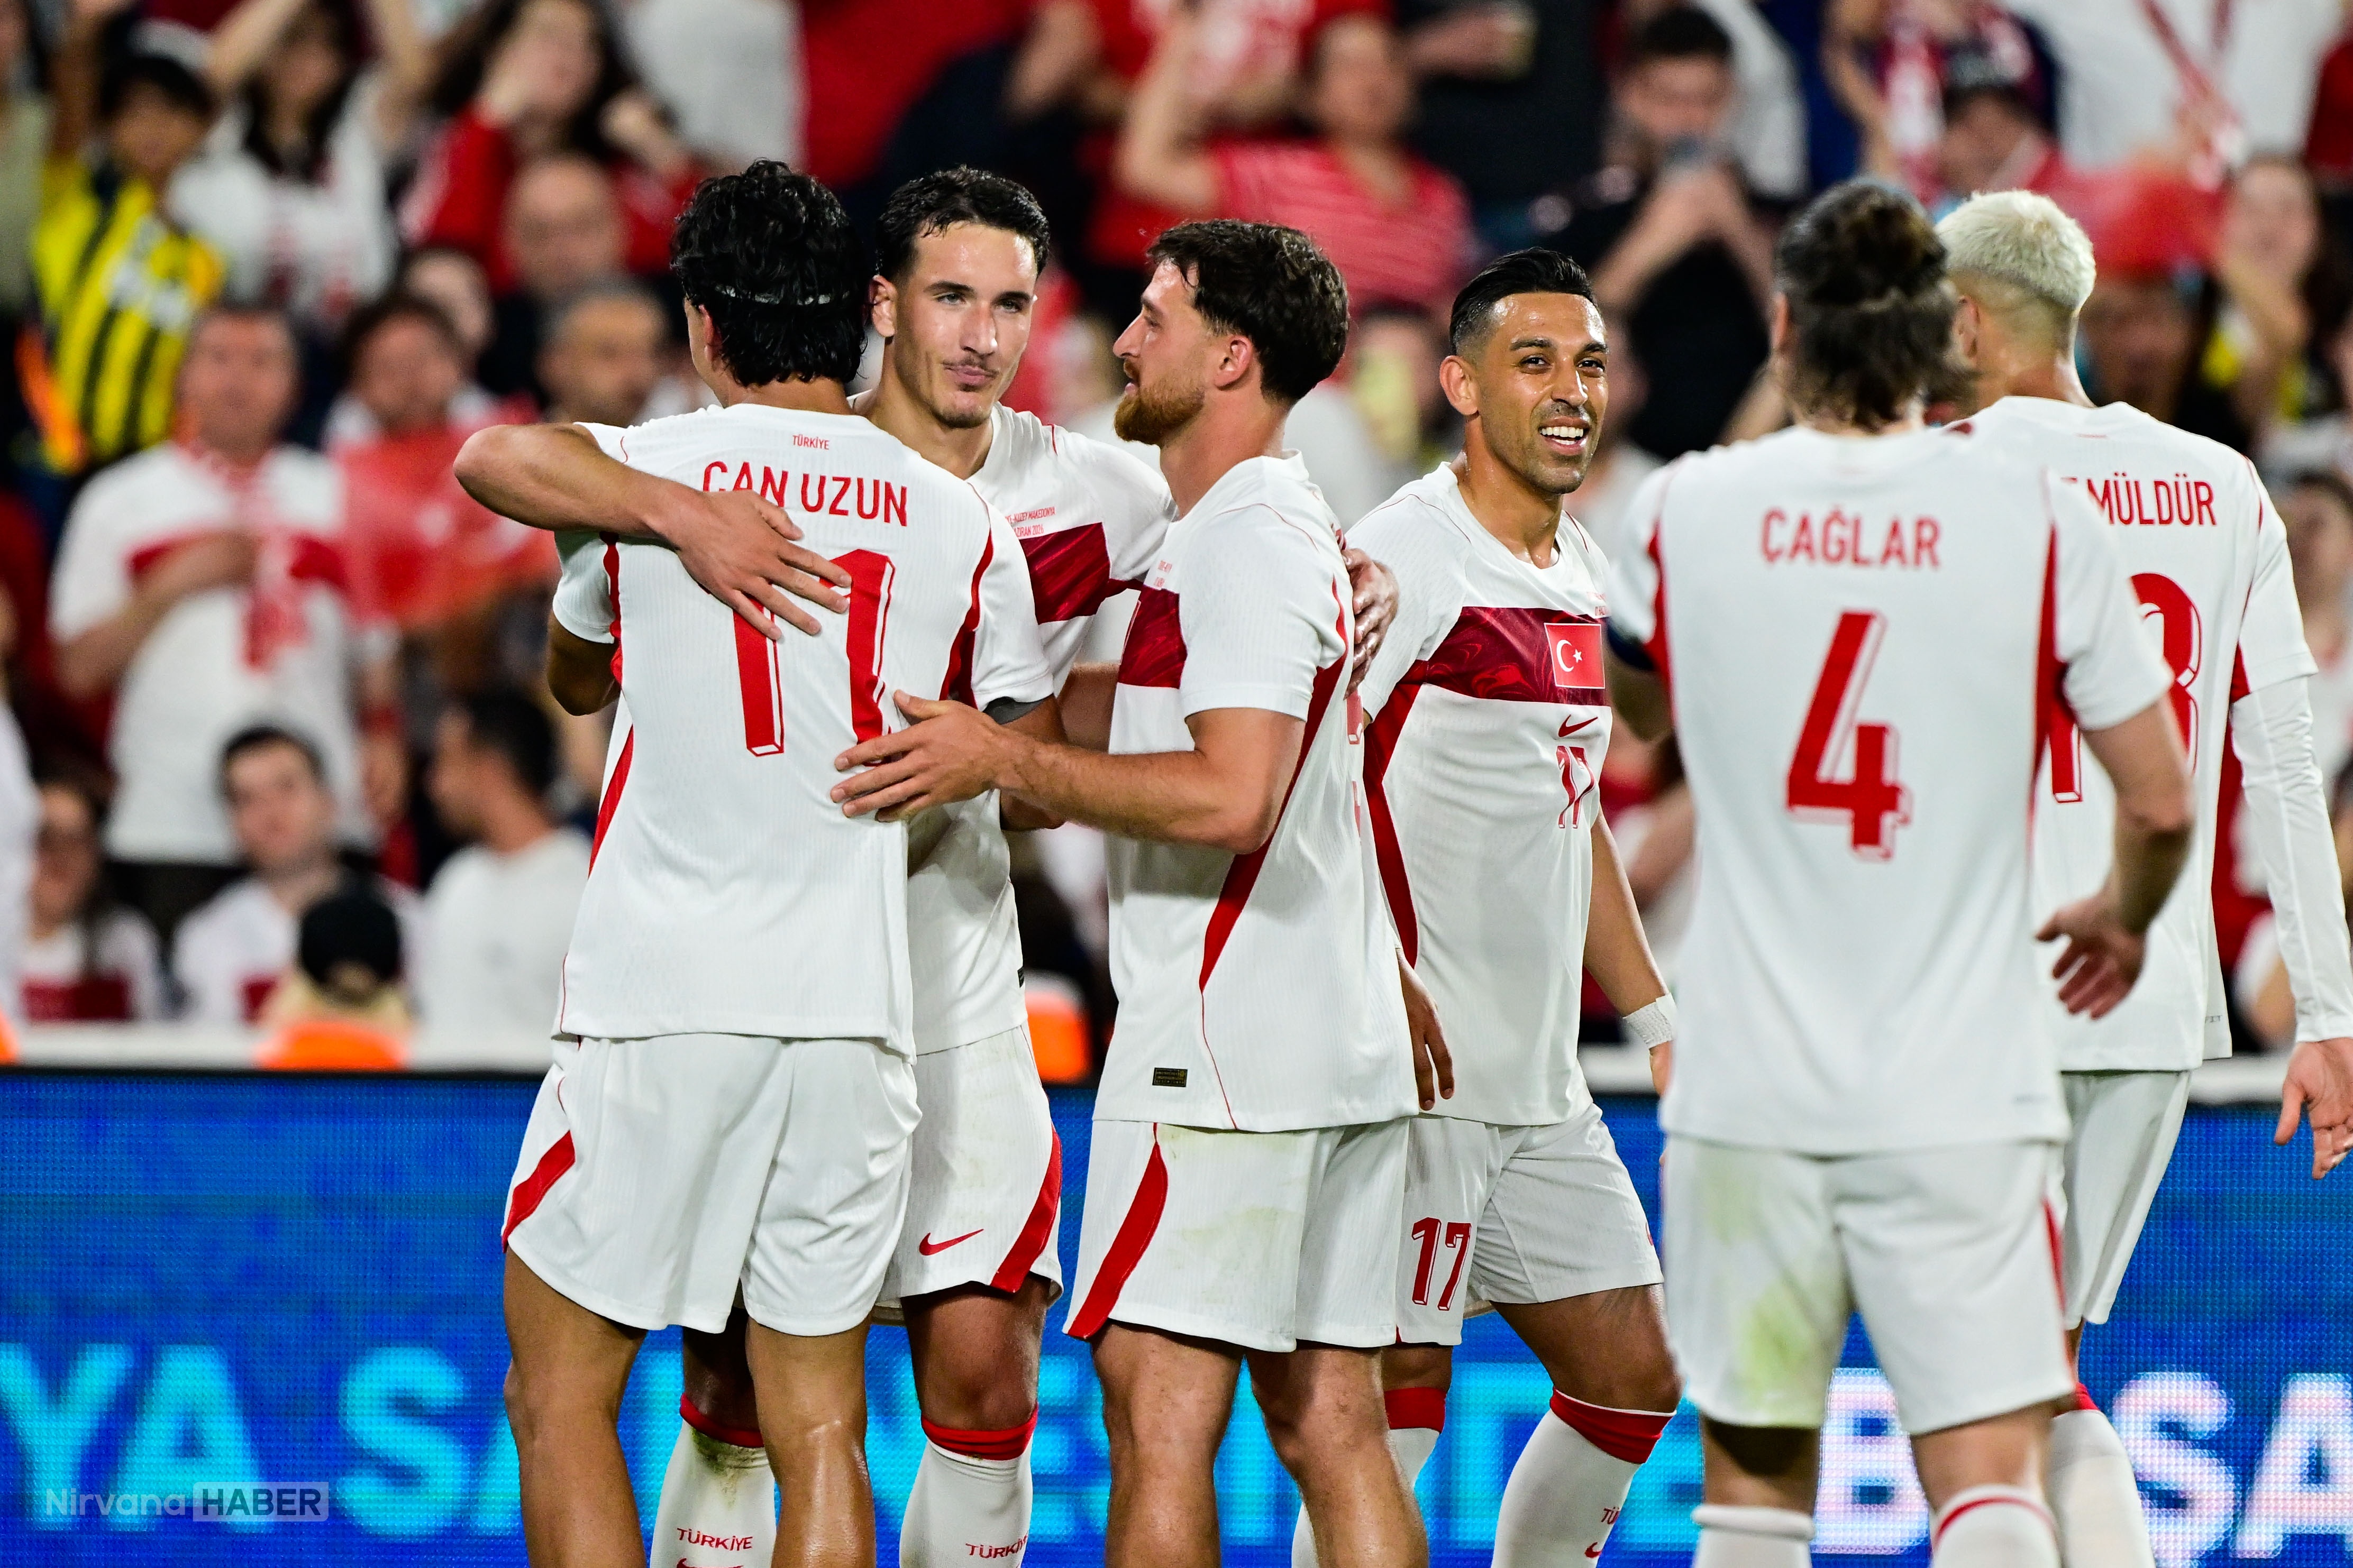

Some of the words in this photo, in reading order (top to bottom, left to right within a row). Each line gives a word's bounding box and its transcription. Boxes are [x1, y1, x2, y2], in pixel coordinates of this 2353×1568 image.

[792, 434, 830, 451] TÜRKİYE
[702, 461, 789, 508] CAN
[800, 473, 908, 527] UZUN
[2086, 471, 2217, 525] MÜLDÜR
[1761, 504, 1944, 568] ÇAĞLAR
[1785, 608, 1913, 861] 4
[1411, 1216, 1472, 1312] 17
[677, 1527, 753, 1551] TÜRKİYE
